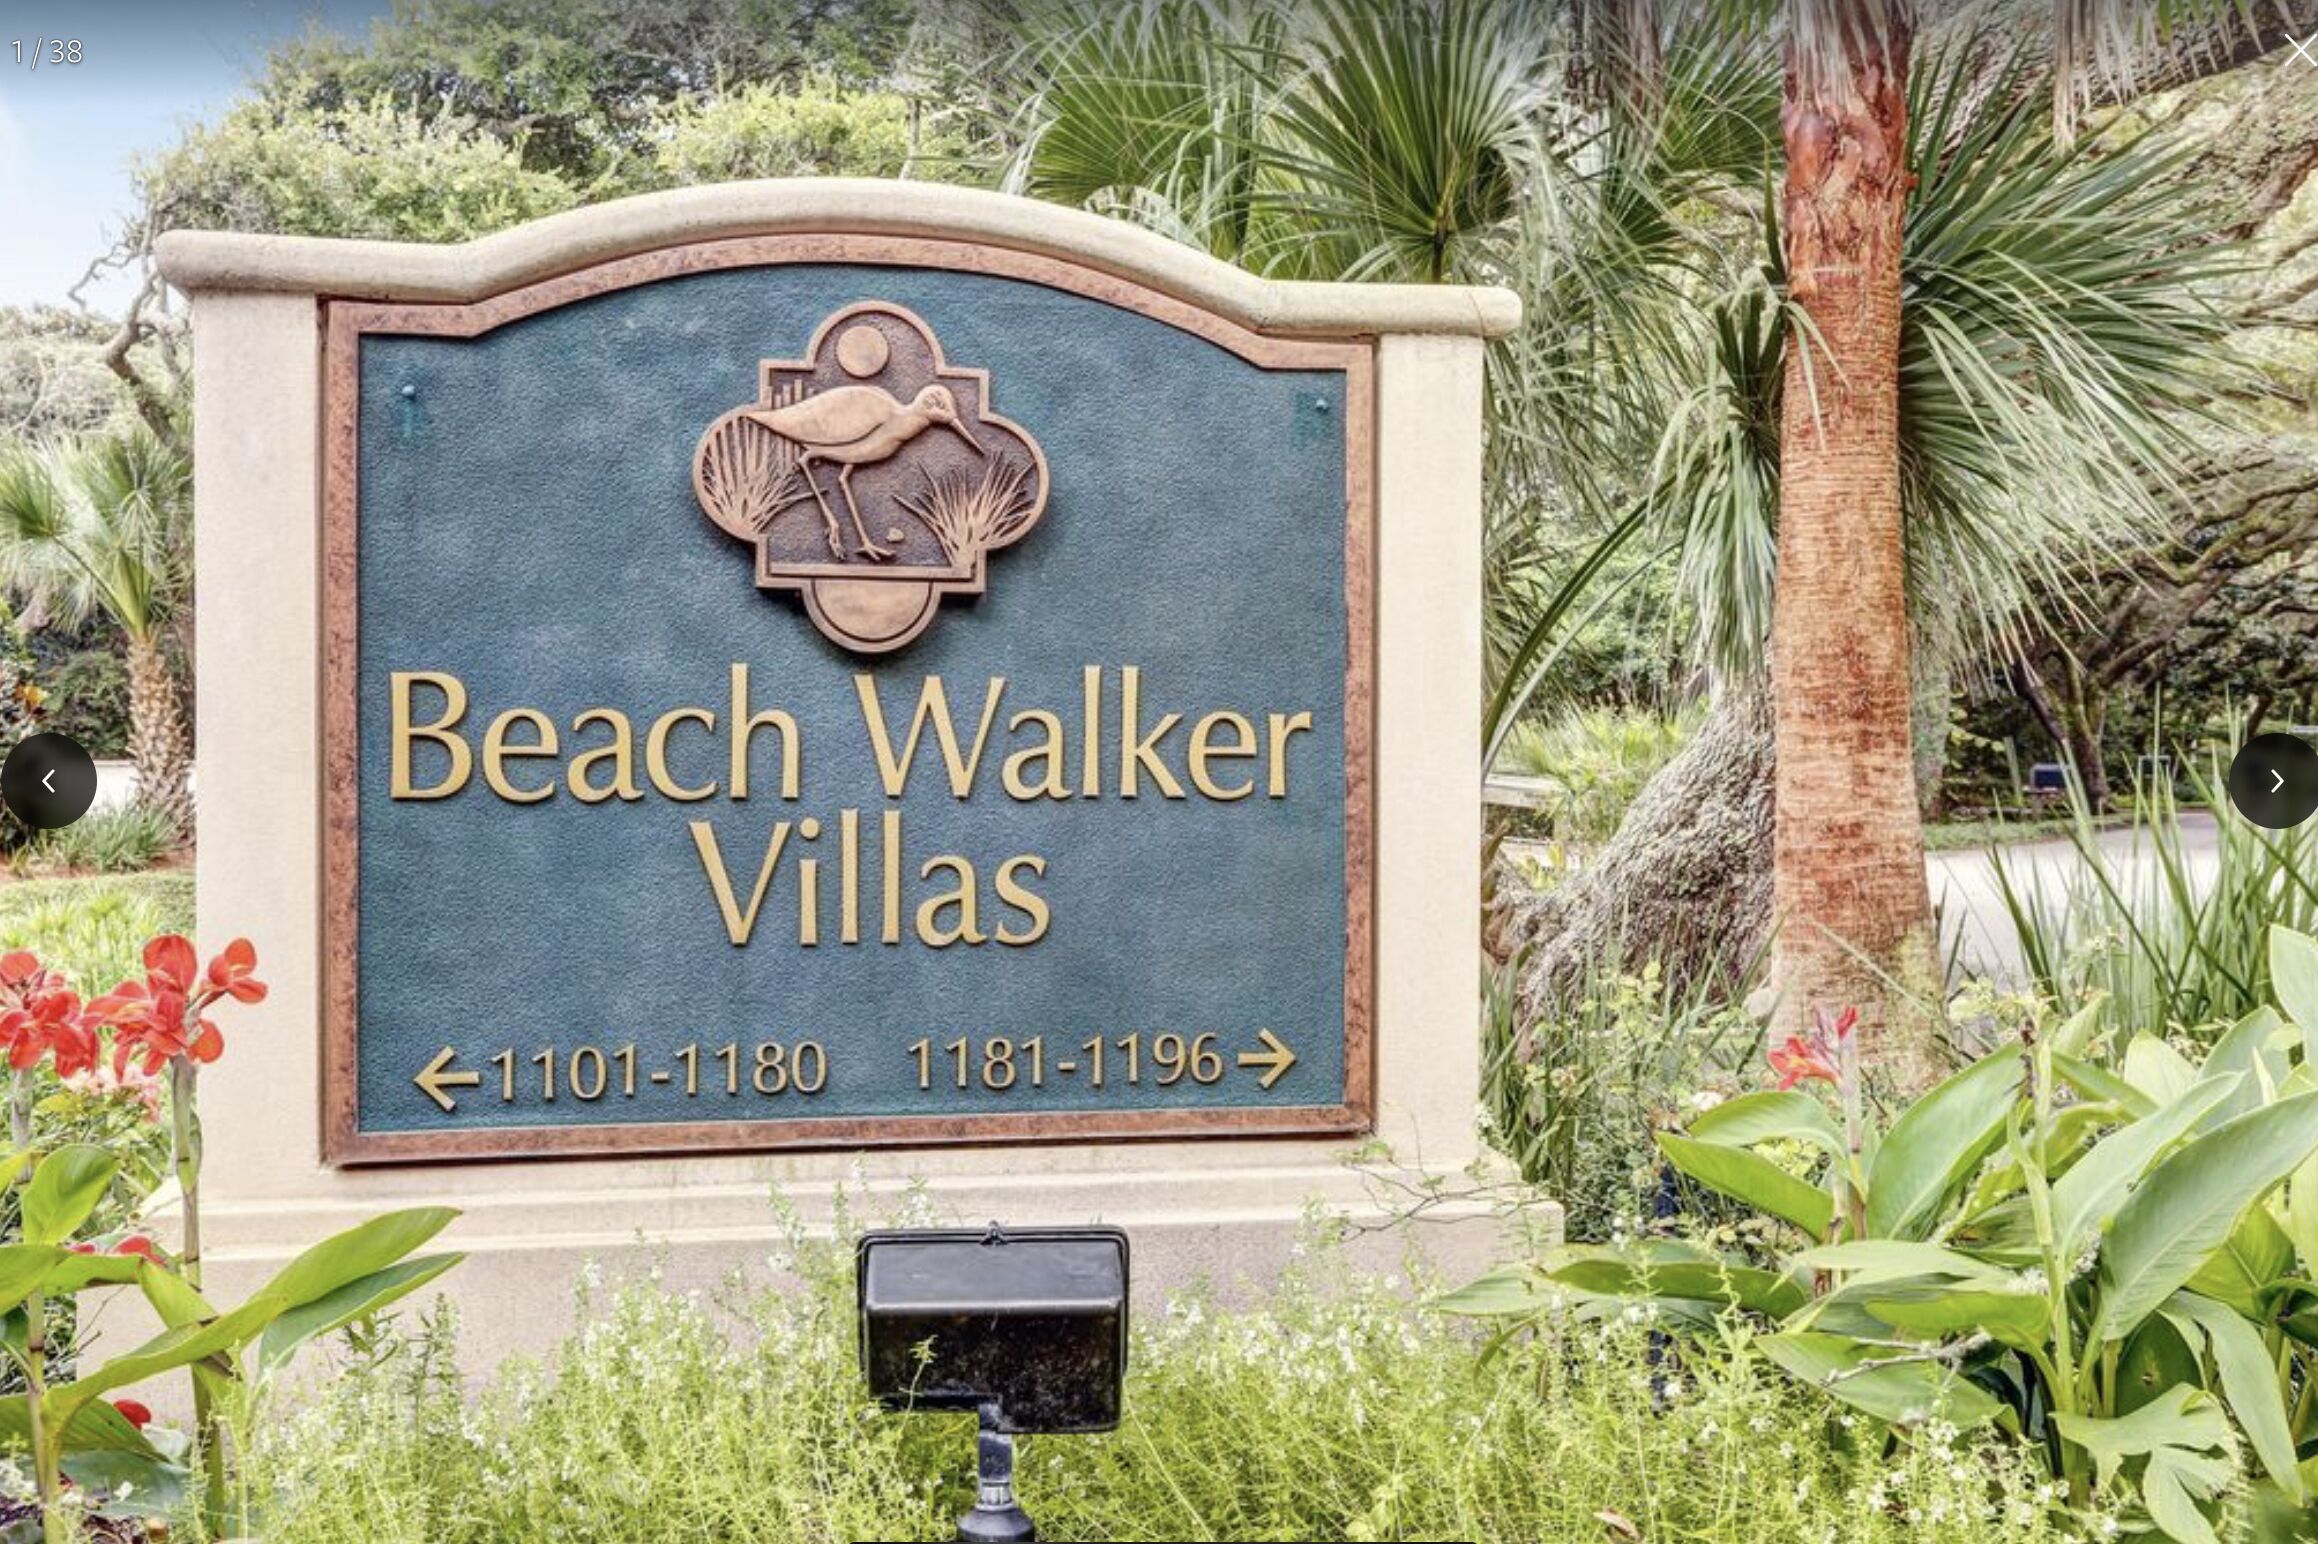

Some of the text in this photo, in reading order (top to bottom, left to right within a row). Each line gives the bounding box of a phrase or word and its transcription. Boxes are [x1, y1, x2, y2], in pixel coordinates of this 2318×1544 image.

[389, 662, 1313, 802] Beach Walker
[689, 807, 1051, 948] Villas
[491, 1041, 828, 1100] 1101-1180
[908, 1031, 1224, 1089] 1181-1196
